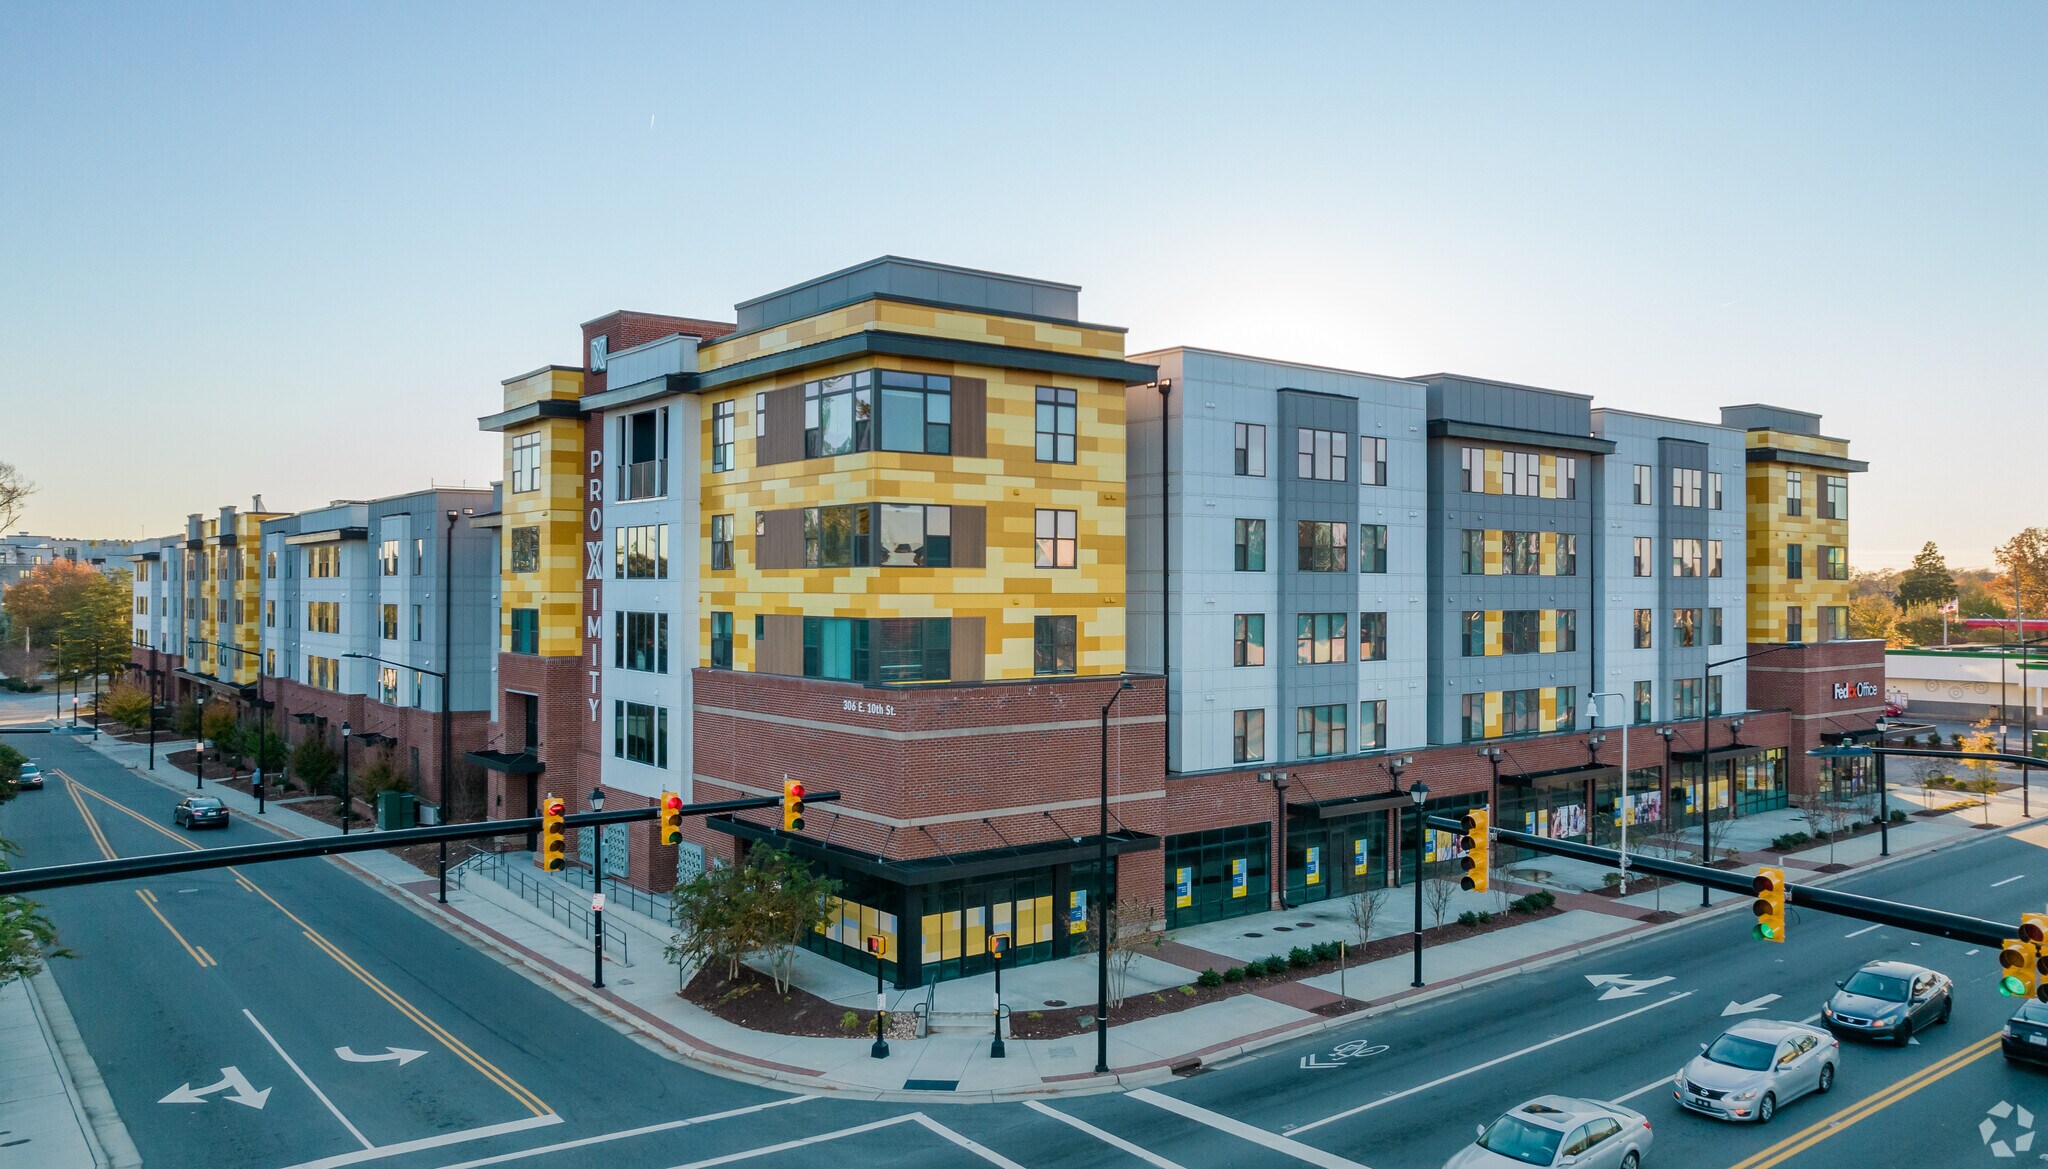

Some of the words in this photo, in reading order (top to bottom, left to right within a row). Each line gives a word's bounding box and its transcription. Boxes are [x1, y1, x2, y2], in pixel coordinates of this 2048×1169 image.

[586, 450, 604, 722] PROXIMITY
[1834, 682, 1857, 699] FedEx
[1857, 682, 1877, 697] Office
[843, 700, 856, 711] 306
[858, 702, 865, 712] E.
[867, 703, 884, 714] 10th
[886, 704, 896, 716] St.
